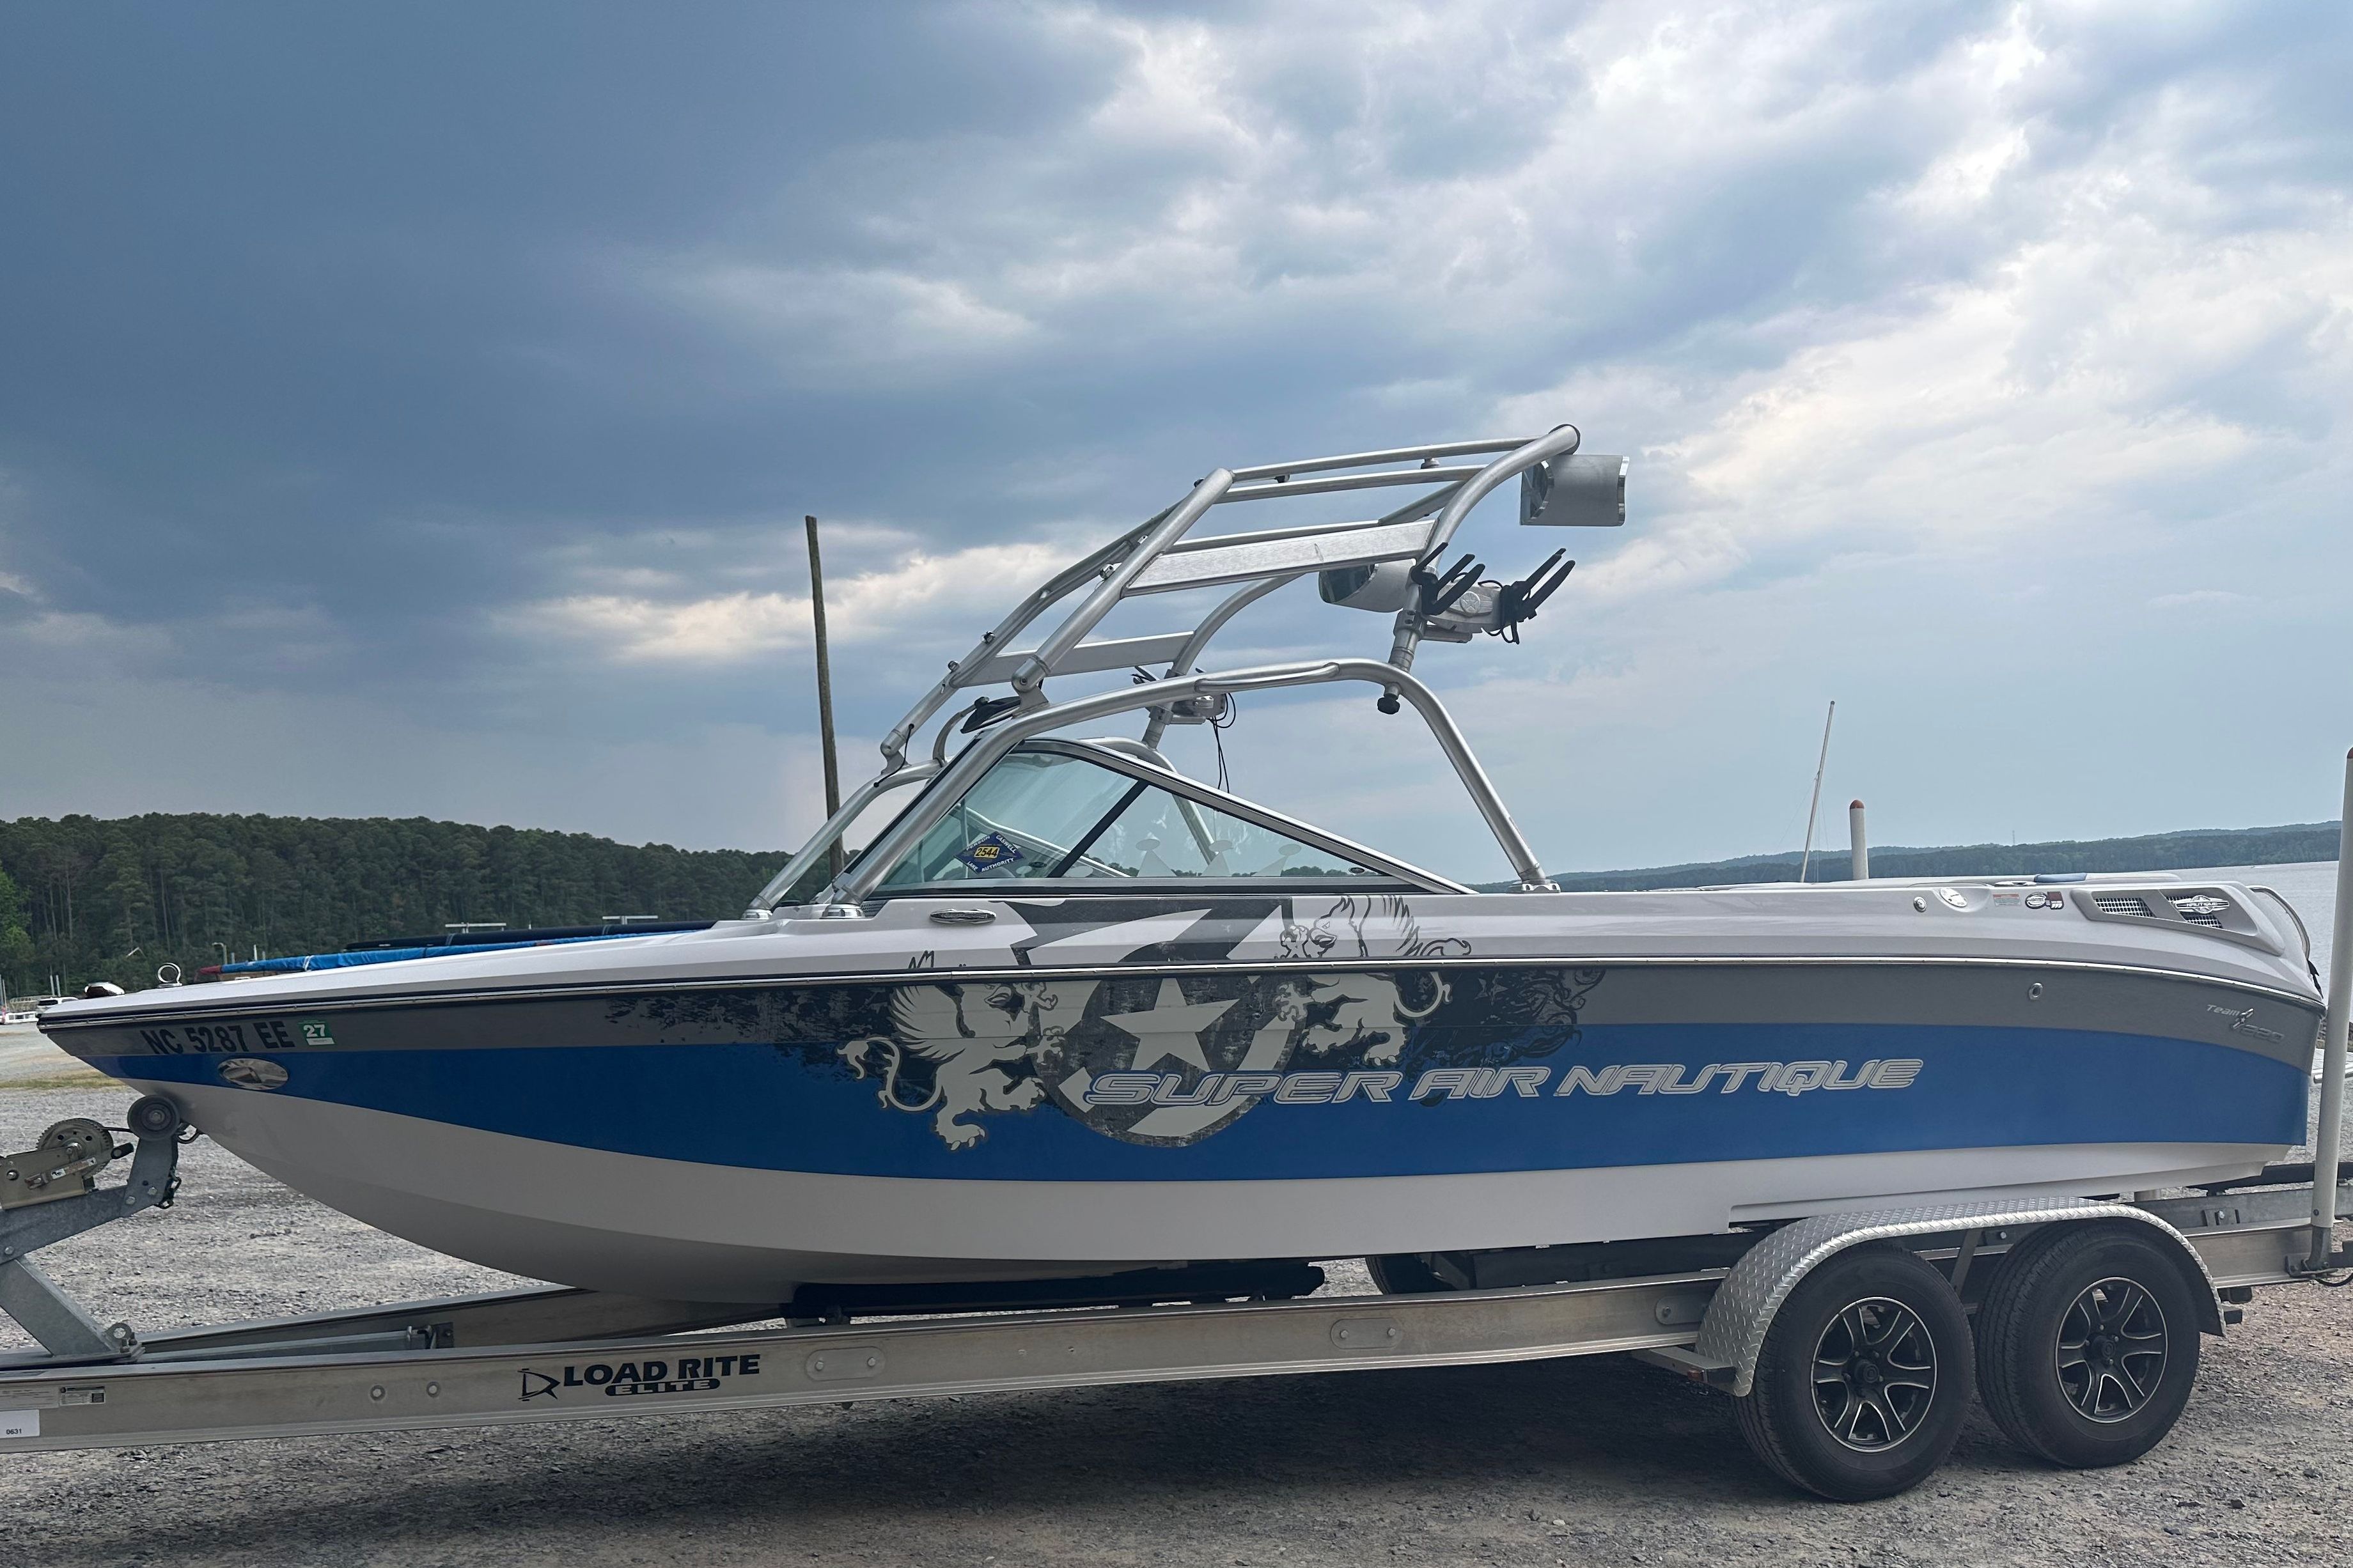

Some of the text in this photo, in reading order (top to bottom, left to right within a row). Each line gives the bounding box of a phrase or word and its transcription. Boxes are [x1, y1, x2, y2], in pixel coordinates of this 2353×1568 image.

[996, 834, 1017, 854] CASWELL
[975, 848, 998, 857] 2544
[967, 857, 1015, 872] LAKE AUTHORITY
[2206, 1004, 2240, 1016] Team
[140, 1021, 295, 1054] NC 5287 EE
[303, 1024, 325, 1037] 27
[1086, 1059, 1923, 1105] SUPER AIR NAUTIQUE
[564, 1354, 761, 1386] LOAD RITE
[615, 1380, 711, 1395] ELITE
